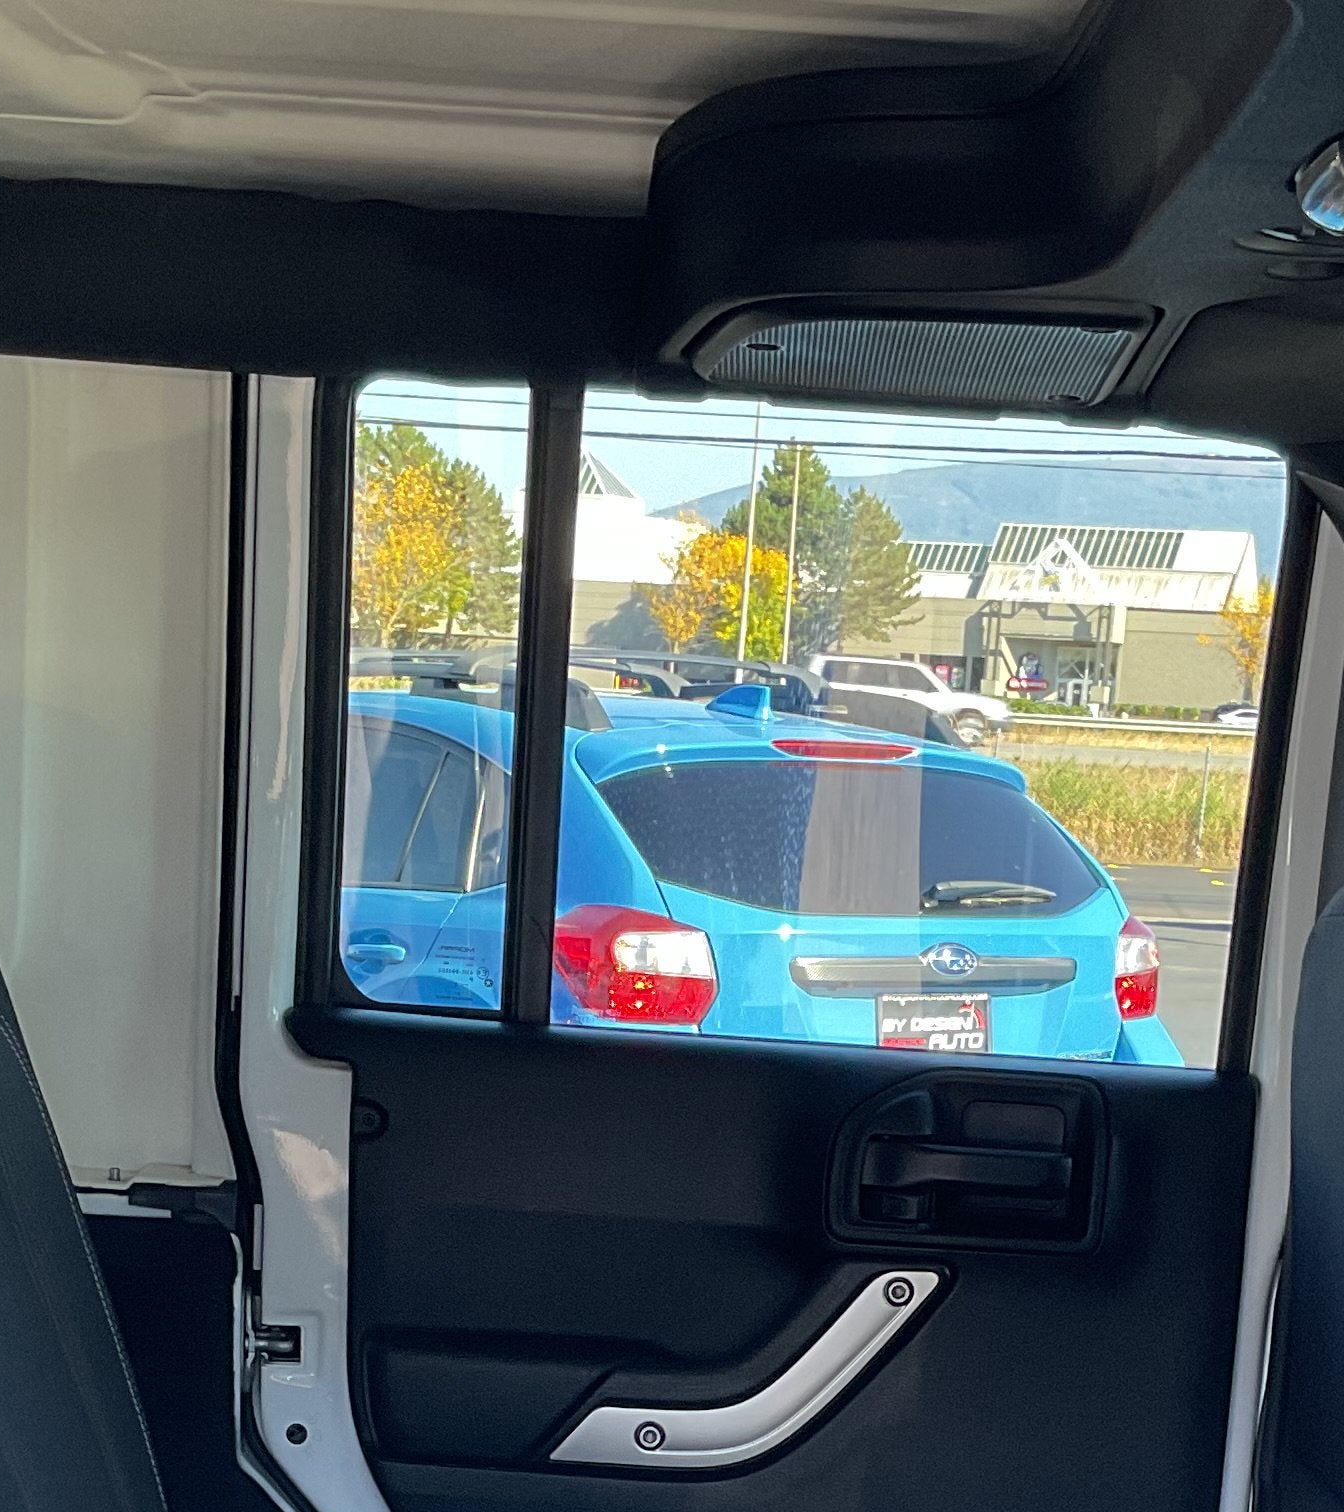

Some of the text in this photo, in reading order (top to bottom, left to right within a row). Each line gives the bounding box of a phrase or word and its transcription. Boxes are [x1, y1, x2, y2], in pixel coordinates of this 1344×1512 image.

[881, 1016, 974, 1033] BY DESIGN
[928, 1032, 984, 1050] AUTO
